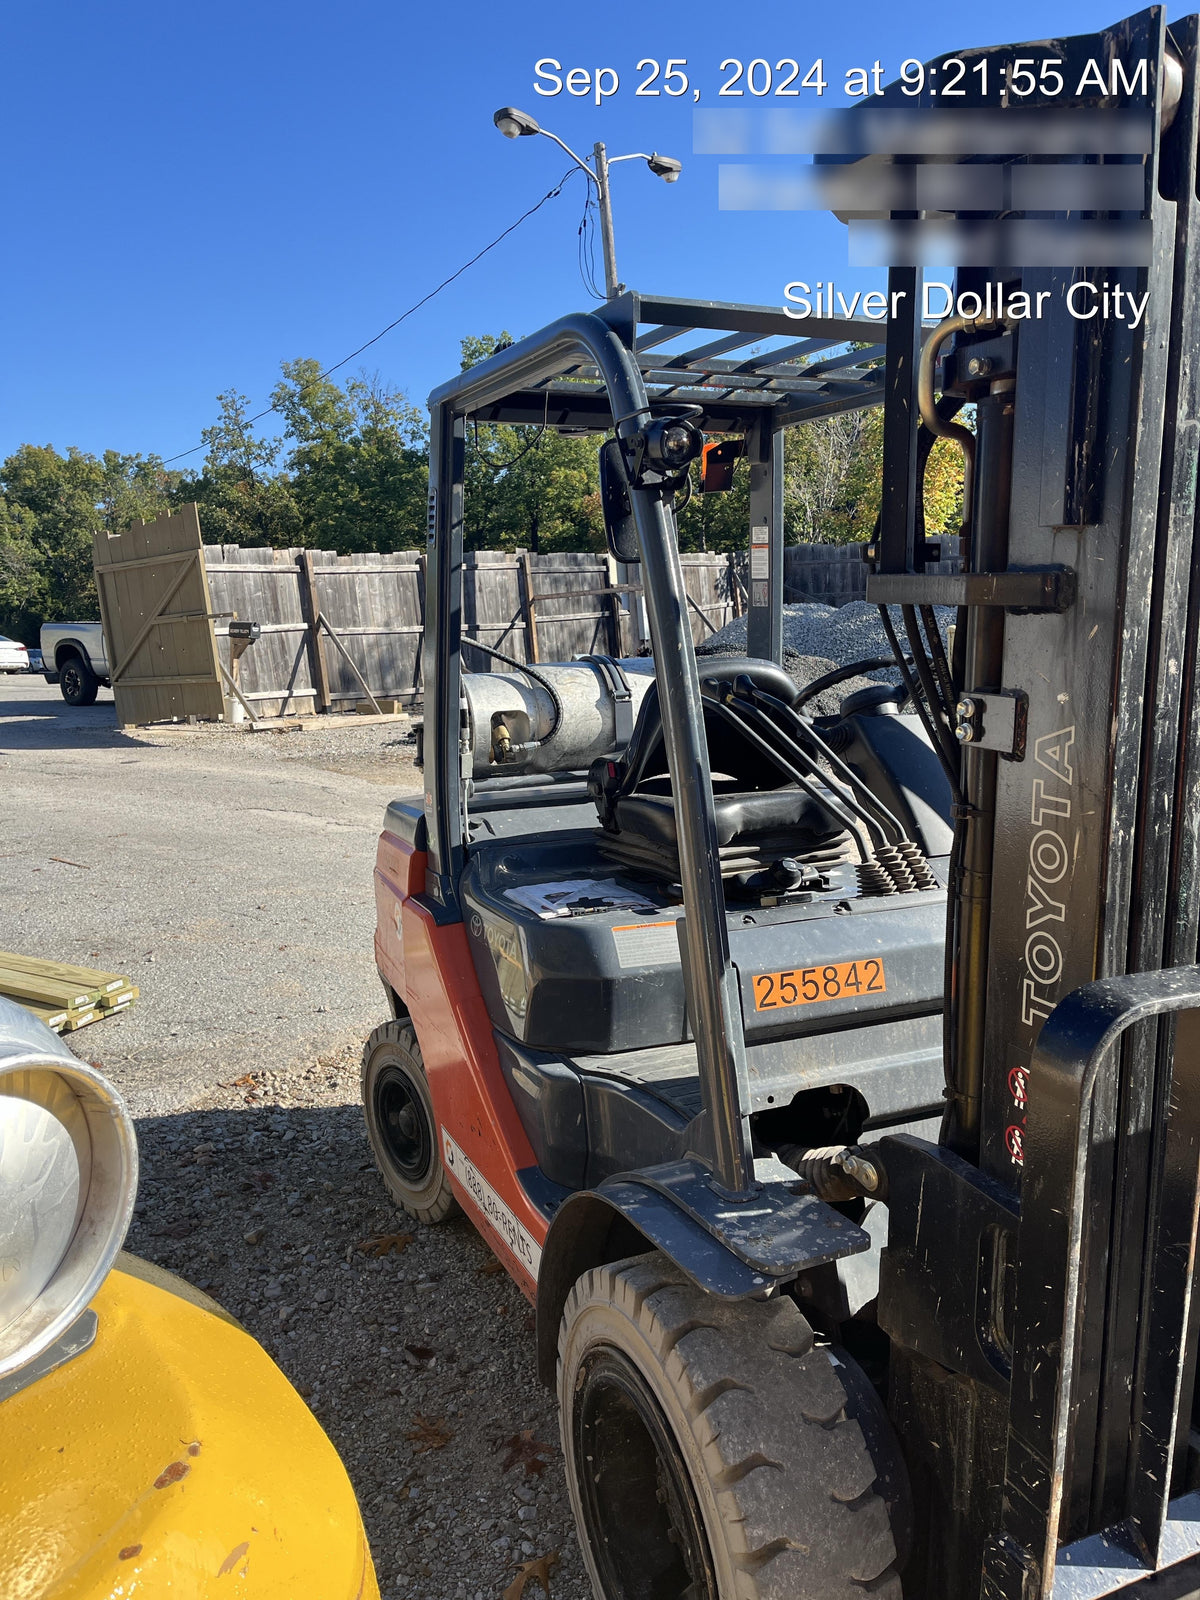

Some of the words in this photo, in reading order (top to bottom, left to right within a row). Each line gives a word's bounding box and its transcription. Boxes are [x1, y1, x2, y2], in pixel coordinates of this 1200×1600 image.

[1021, 726, 1077, 1026] TOYOTA
[484, 923, 518, 960] TOYOTA
[757, 960, 884, 1008] 255842
